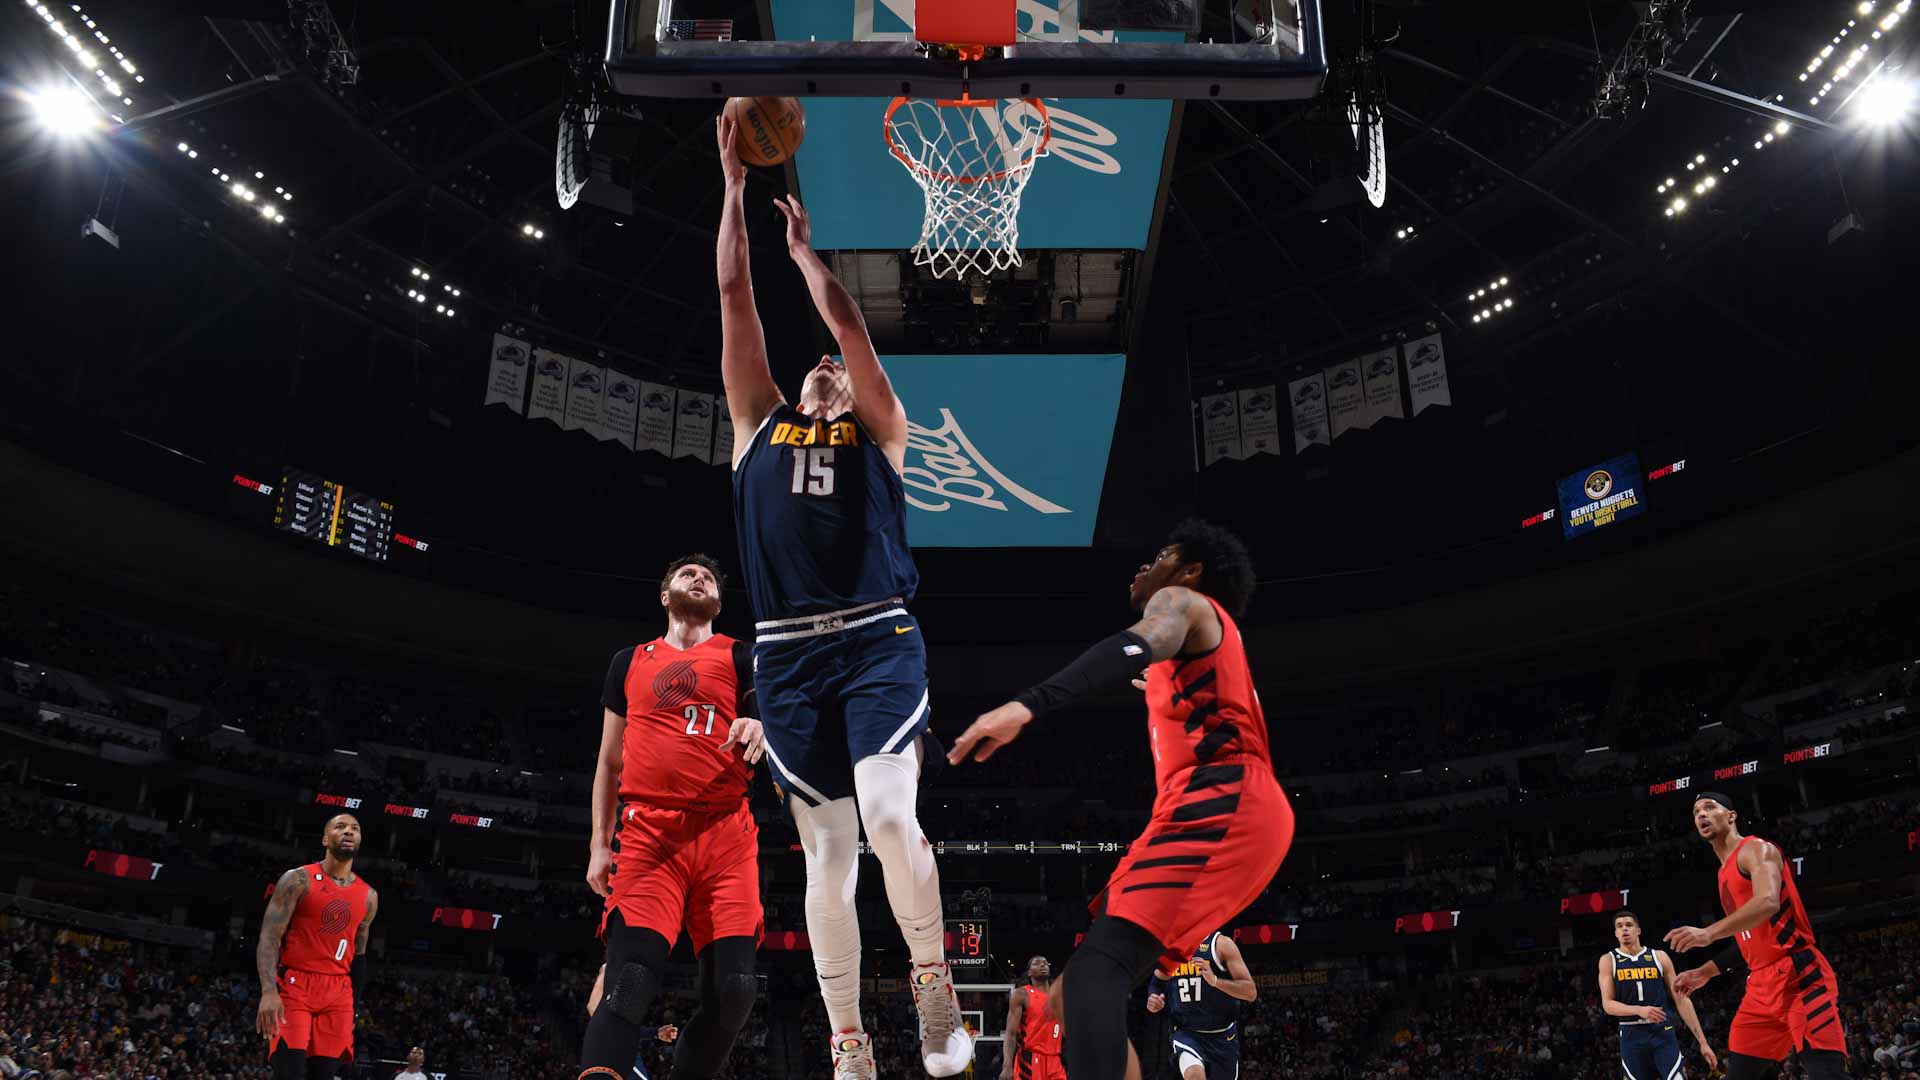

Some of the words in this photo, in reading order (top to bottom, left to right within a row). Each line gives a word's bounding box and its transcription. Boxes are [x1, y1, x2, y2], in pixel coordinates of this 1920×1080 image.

[747, 108, 779, 160] Wilson
[792, 448, 834, 496] 15
[1649, 459, 1686, 480] POINTSBET
[233, 474, 273, 495] POINTSBET
[1569, 513, 1594, 527] YOUTH
[1594, 496, 1639, 518] BASKETBALL
[1571, 501, 1600, 519] DENVER
[1600, 487, 1635, 508] NUGGETS
[1521, 508, 1555, 528] POINTSBET
[1594, 512, 1616, 527] NIGHT
[394, 533, 429, 552] POINTSBET
[684, 703, 716, 735] 27
[1783, 743, 1831, 764] POINTSBET
[1714, 760, 1759, 779] POINTSBET
[1649, 776, 1690, 795] POINTSBET
[315, 793, 362, 809] POINTSBET
[384, 803, 429, 819] POINTSBET
[450, 813, 493, 828] POINTSBET
[1098, 842, 1118, 852] 7:31
[958, 923, 983, 935] 7:31
[335, 939, 348, 961] 0
[961, 935, 980, 956] 19
[1616, 967, 1659, 981] DENVER
[1177, 977, 1202, 1003] 27
[1635, 981, 1644, 1001] 1
[1053, 1023, 1060, 1039] 9
